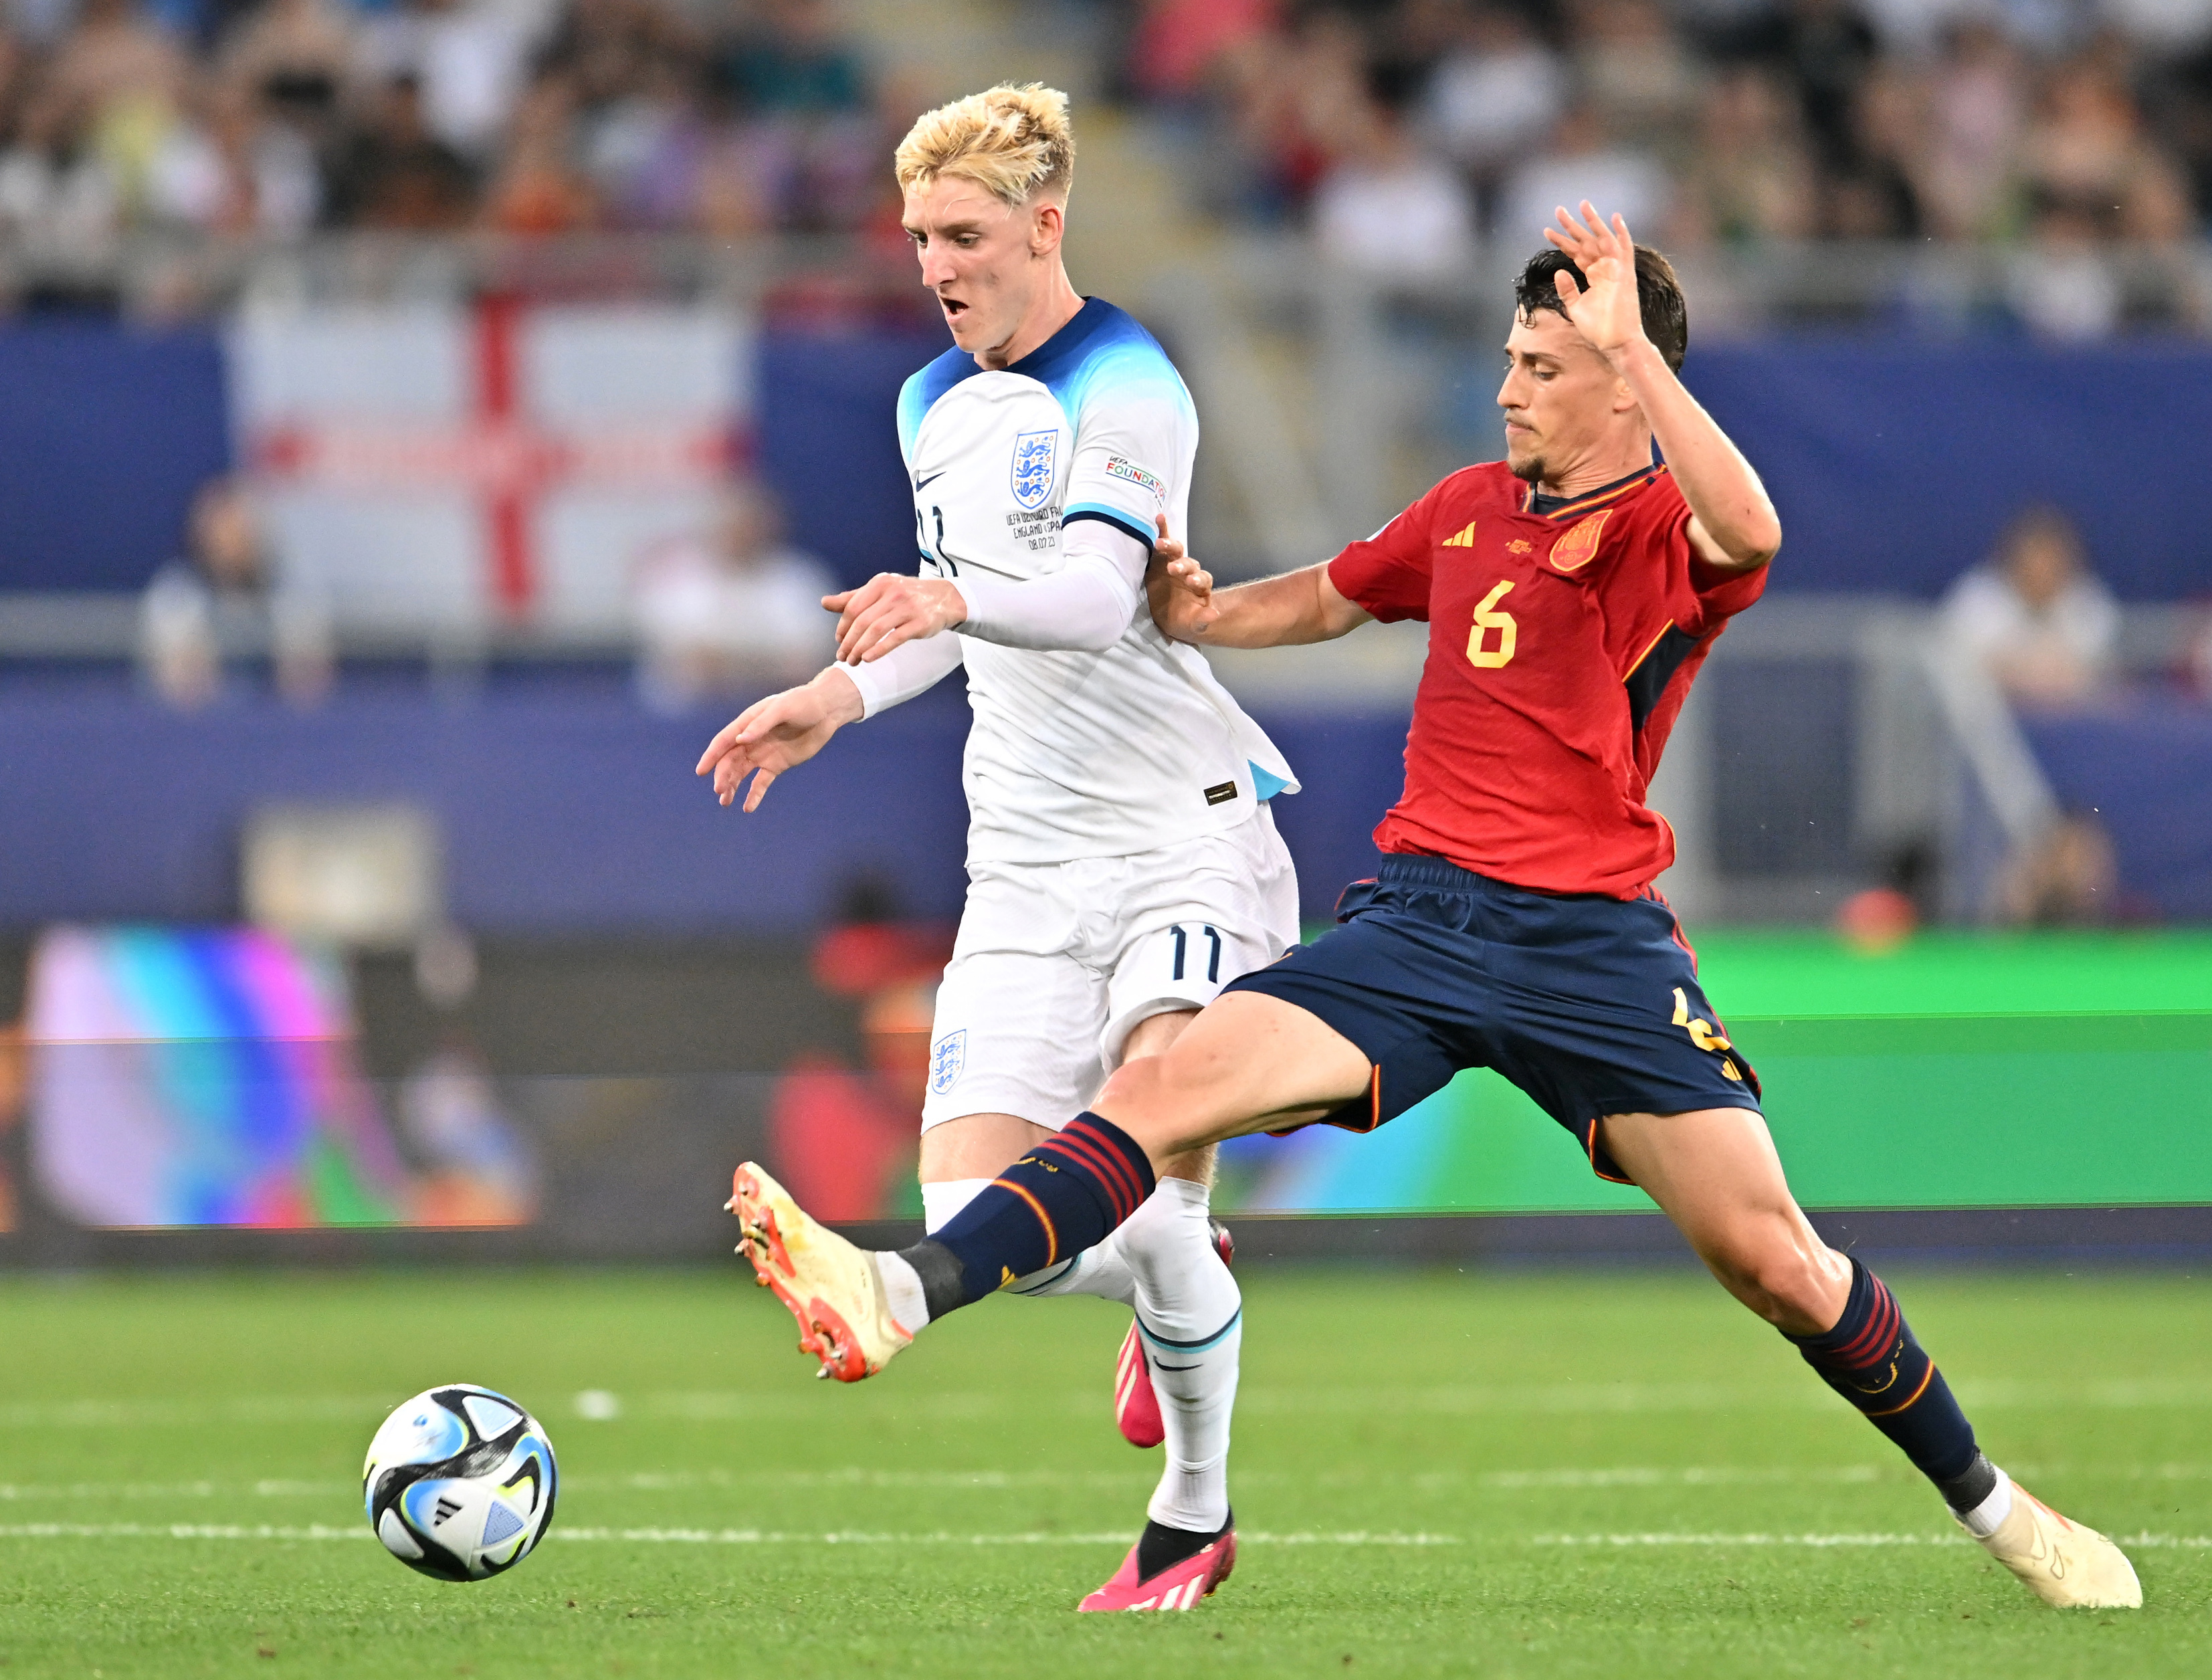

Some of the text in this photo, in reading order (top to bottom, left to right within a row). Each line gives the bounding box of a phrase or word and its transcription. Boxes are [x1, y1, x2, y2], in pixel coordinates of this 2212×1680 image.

[1109, 455, 1128, 465] UEFA
[1006, 512, 1021, 526] UEFA
[1013, 523, 1043, 539] ENGLAND
[1047, 520, 1061, 532] SPA
[1466, 579, 1517, 669] 6
[1171, 924, 1221, 984] 11
